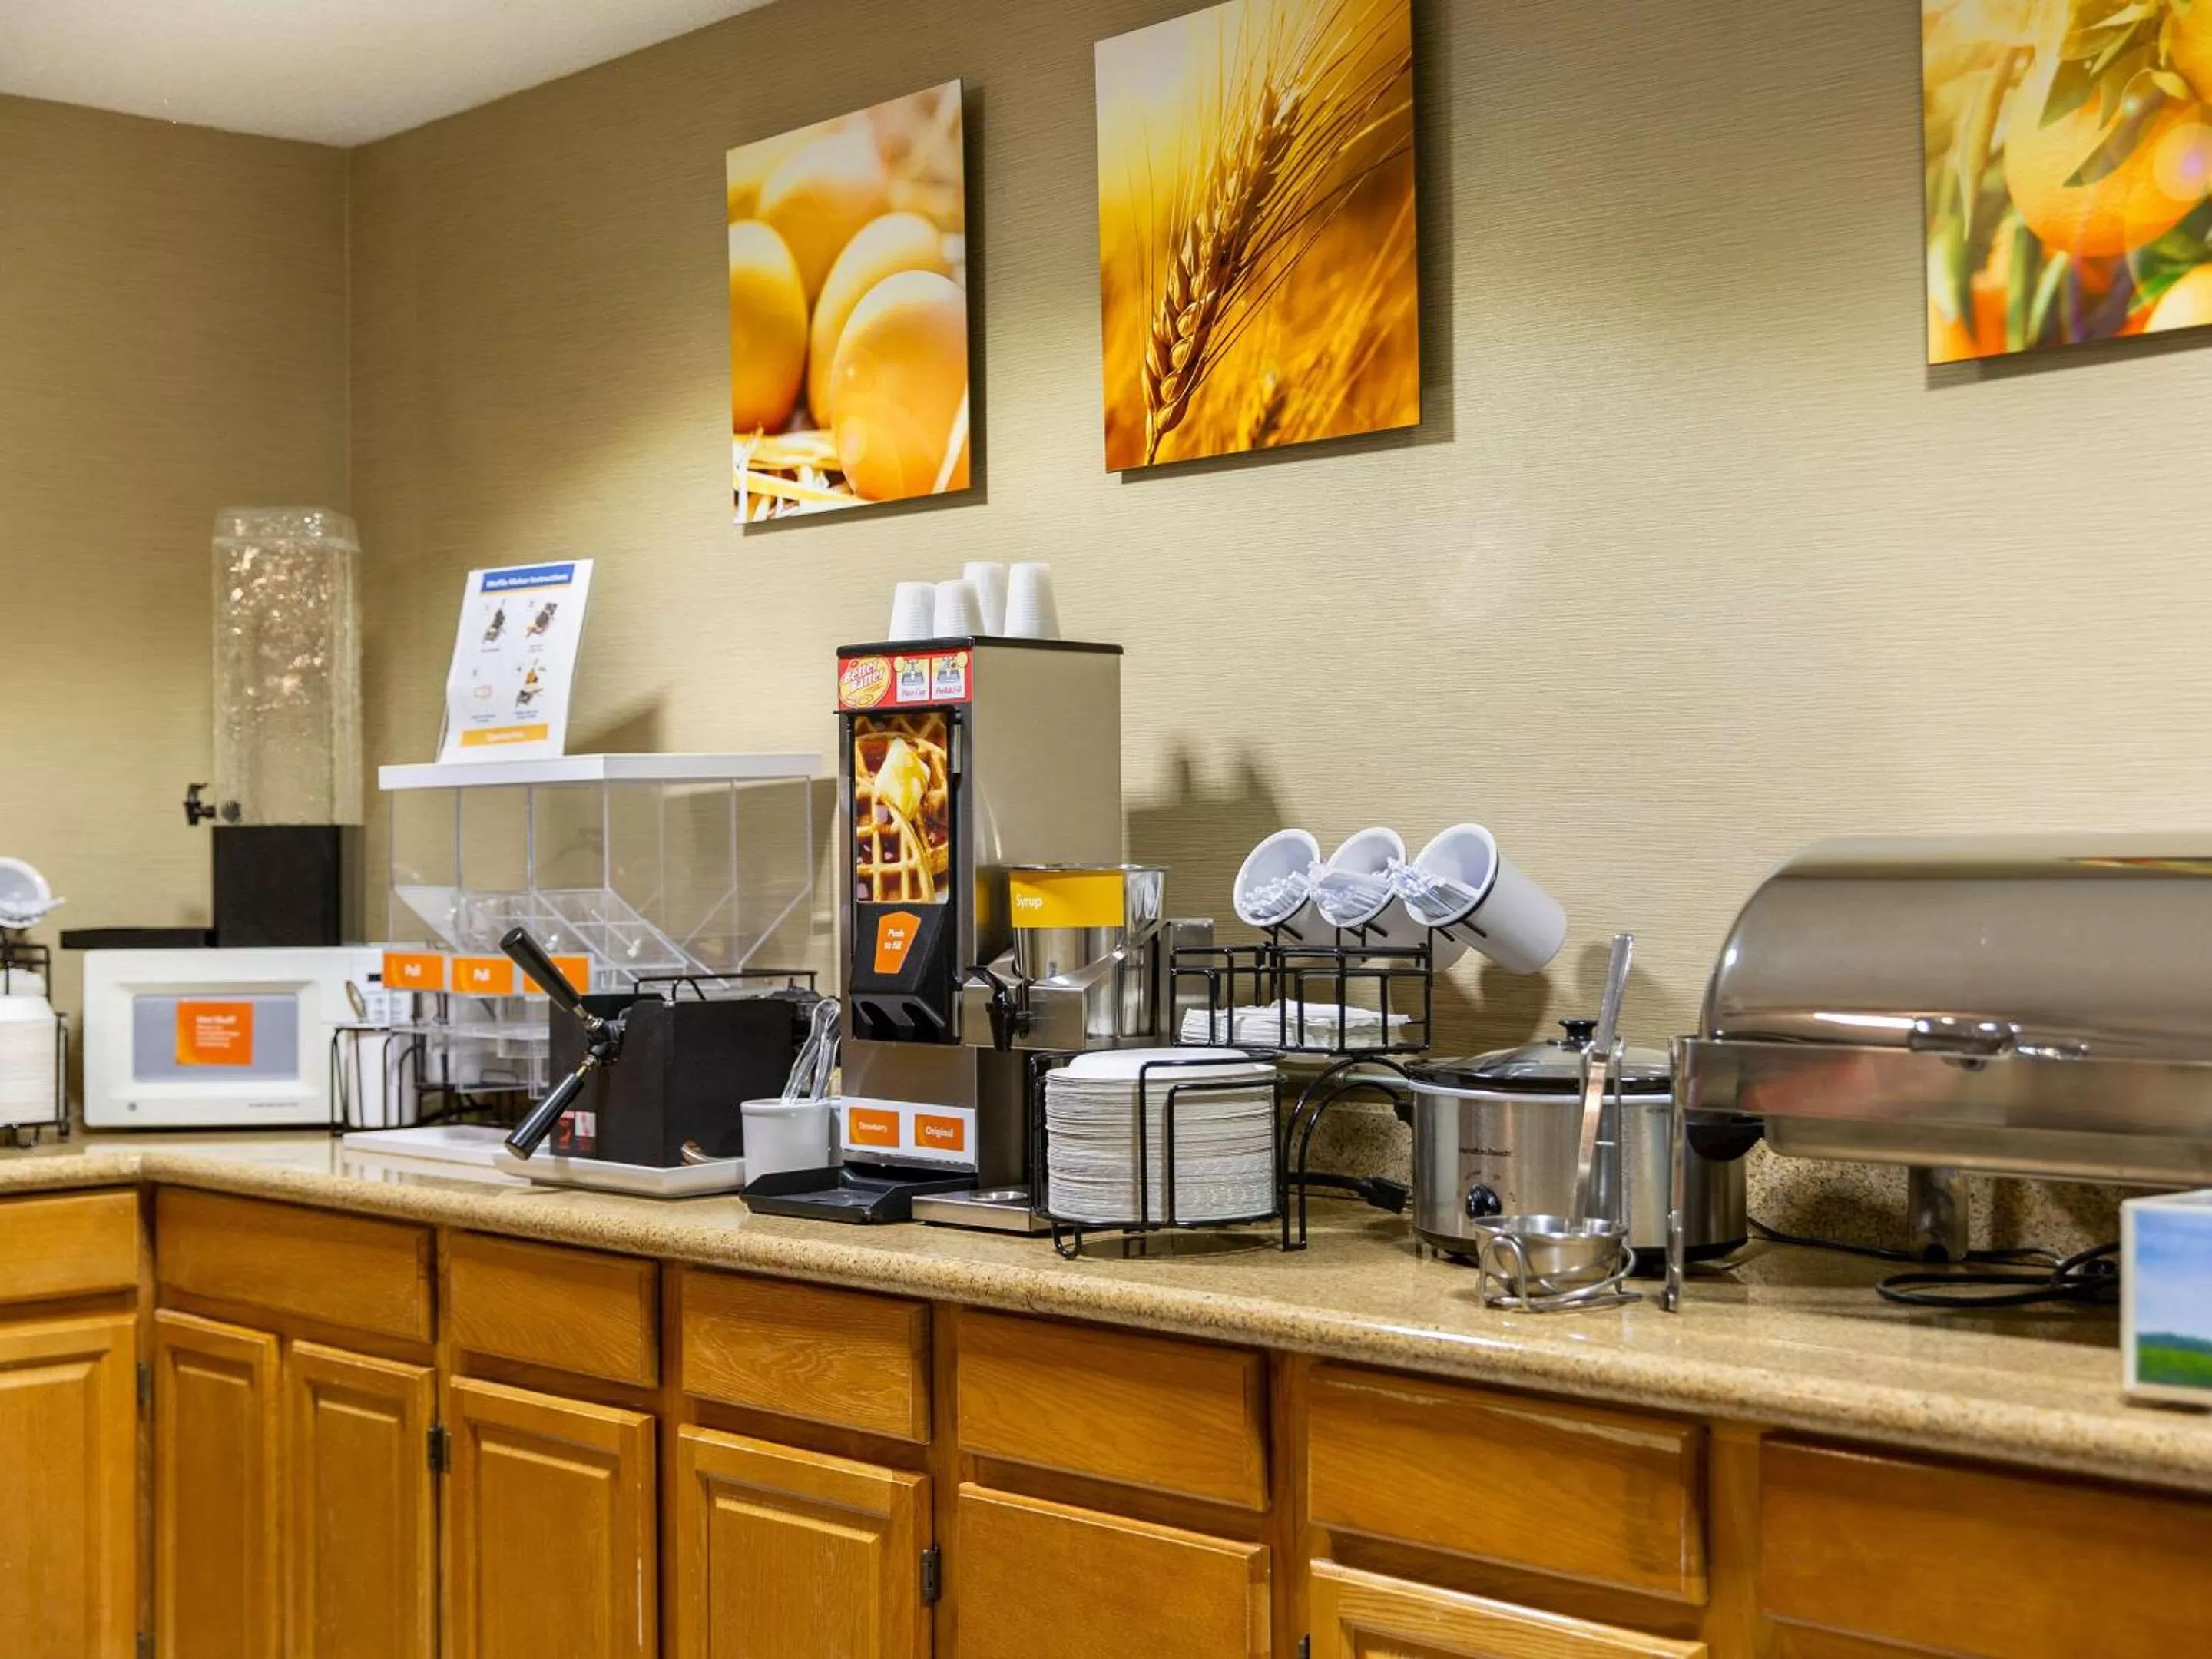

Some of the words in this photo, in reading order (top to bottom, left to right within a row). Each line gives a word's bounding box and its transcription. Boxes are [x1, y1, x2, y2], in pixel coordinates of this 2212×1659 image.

[844, 661, 879, 683] Better
[1015, 893, 1043, 909] Syrup
[925, 1125, 954, 1139] Original
